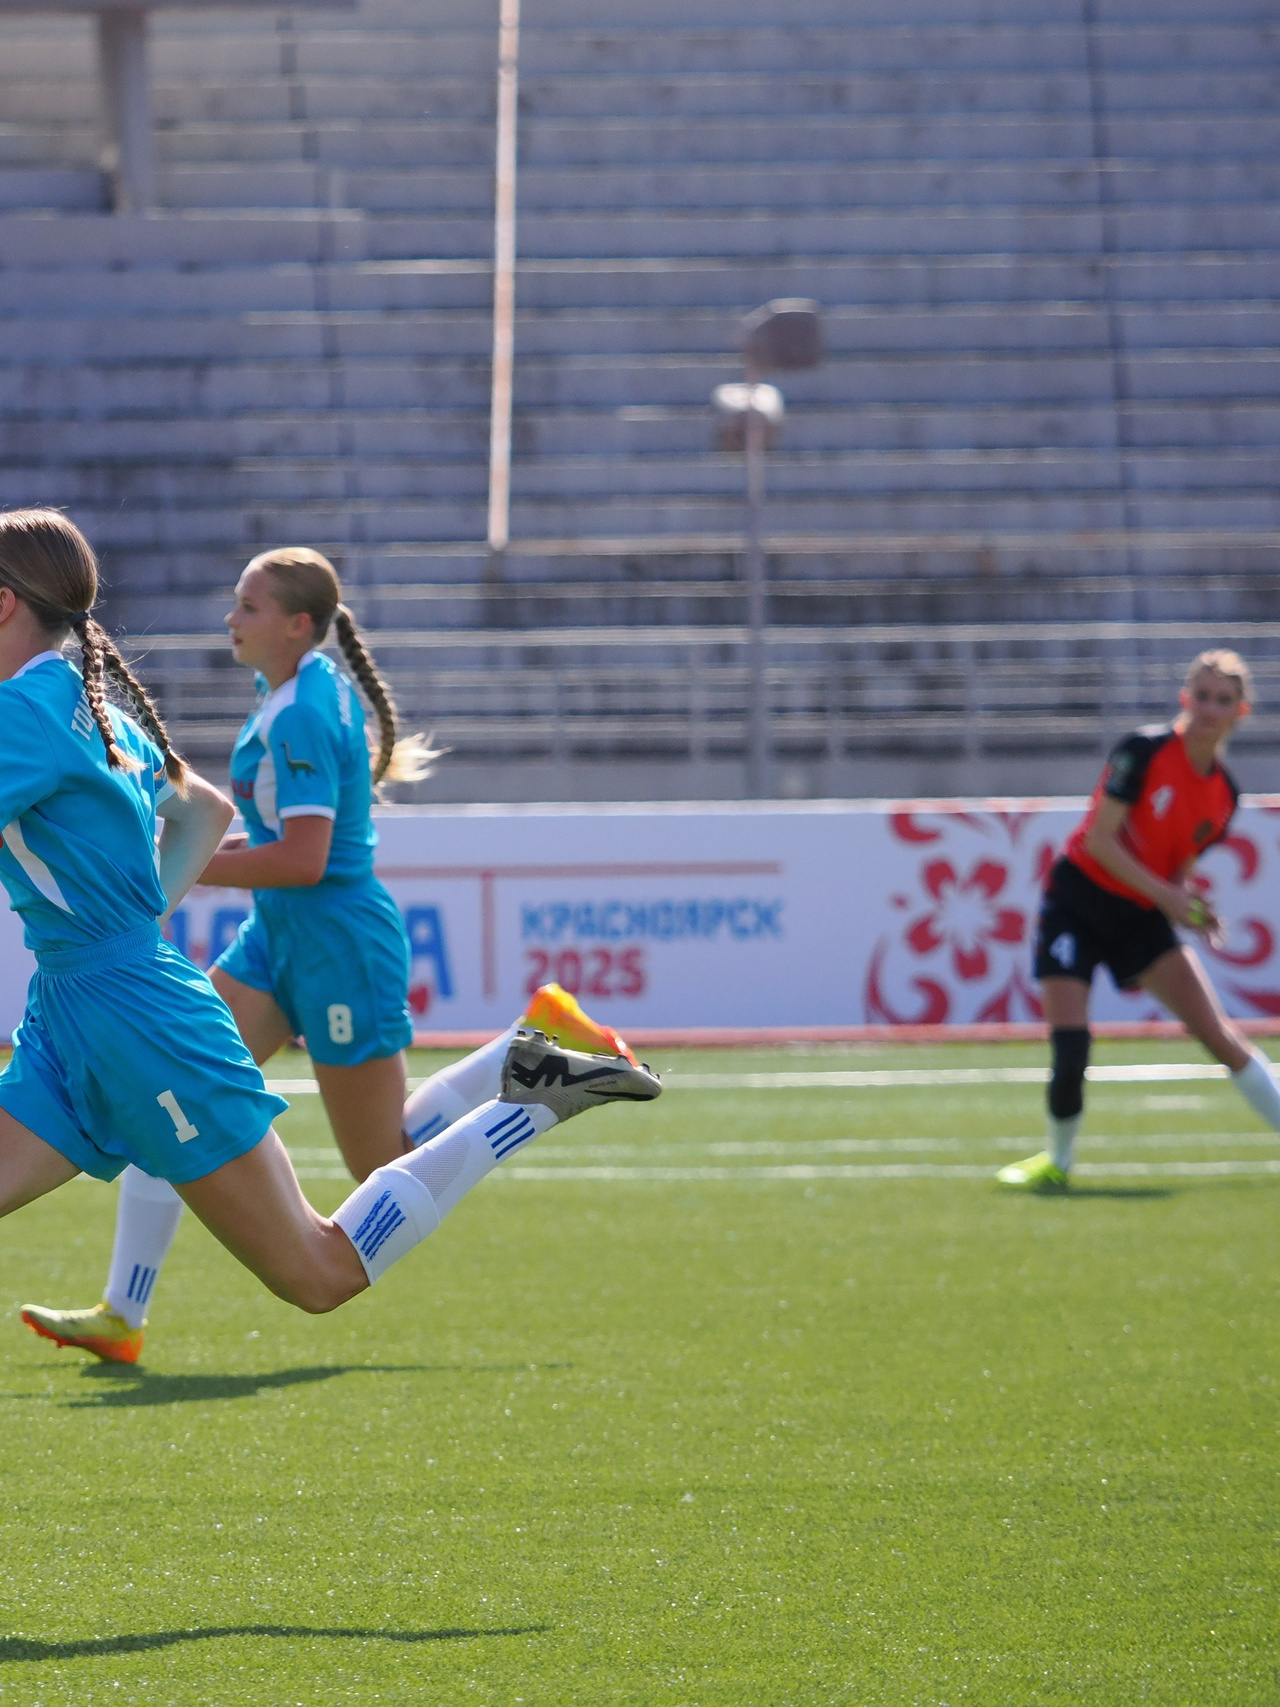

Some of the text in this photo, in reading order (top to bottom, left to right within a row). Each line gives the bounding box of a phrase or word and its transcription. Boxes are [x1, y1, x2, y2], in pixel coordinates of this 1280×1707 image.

[524, 946, 646, 997] 2025
[1050, 932, 1076, 969] 4
[327, 1003, 354, 1045] 8
[156, 1089, 199, 1143] 1
